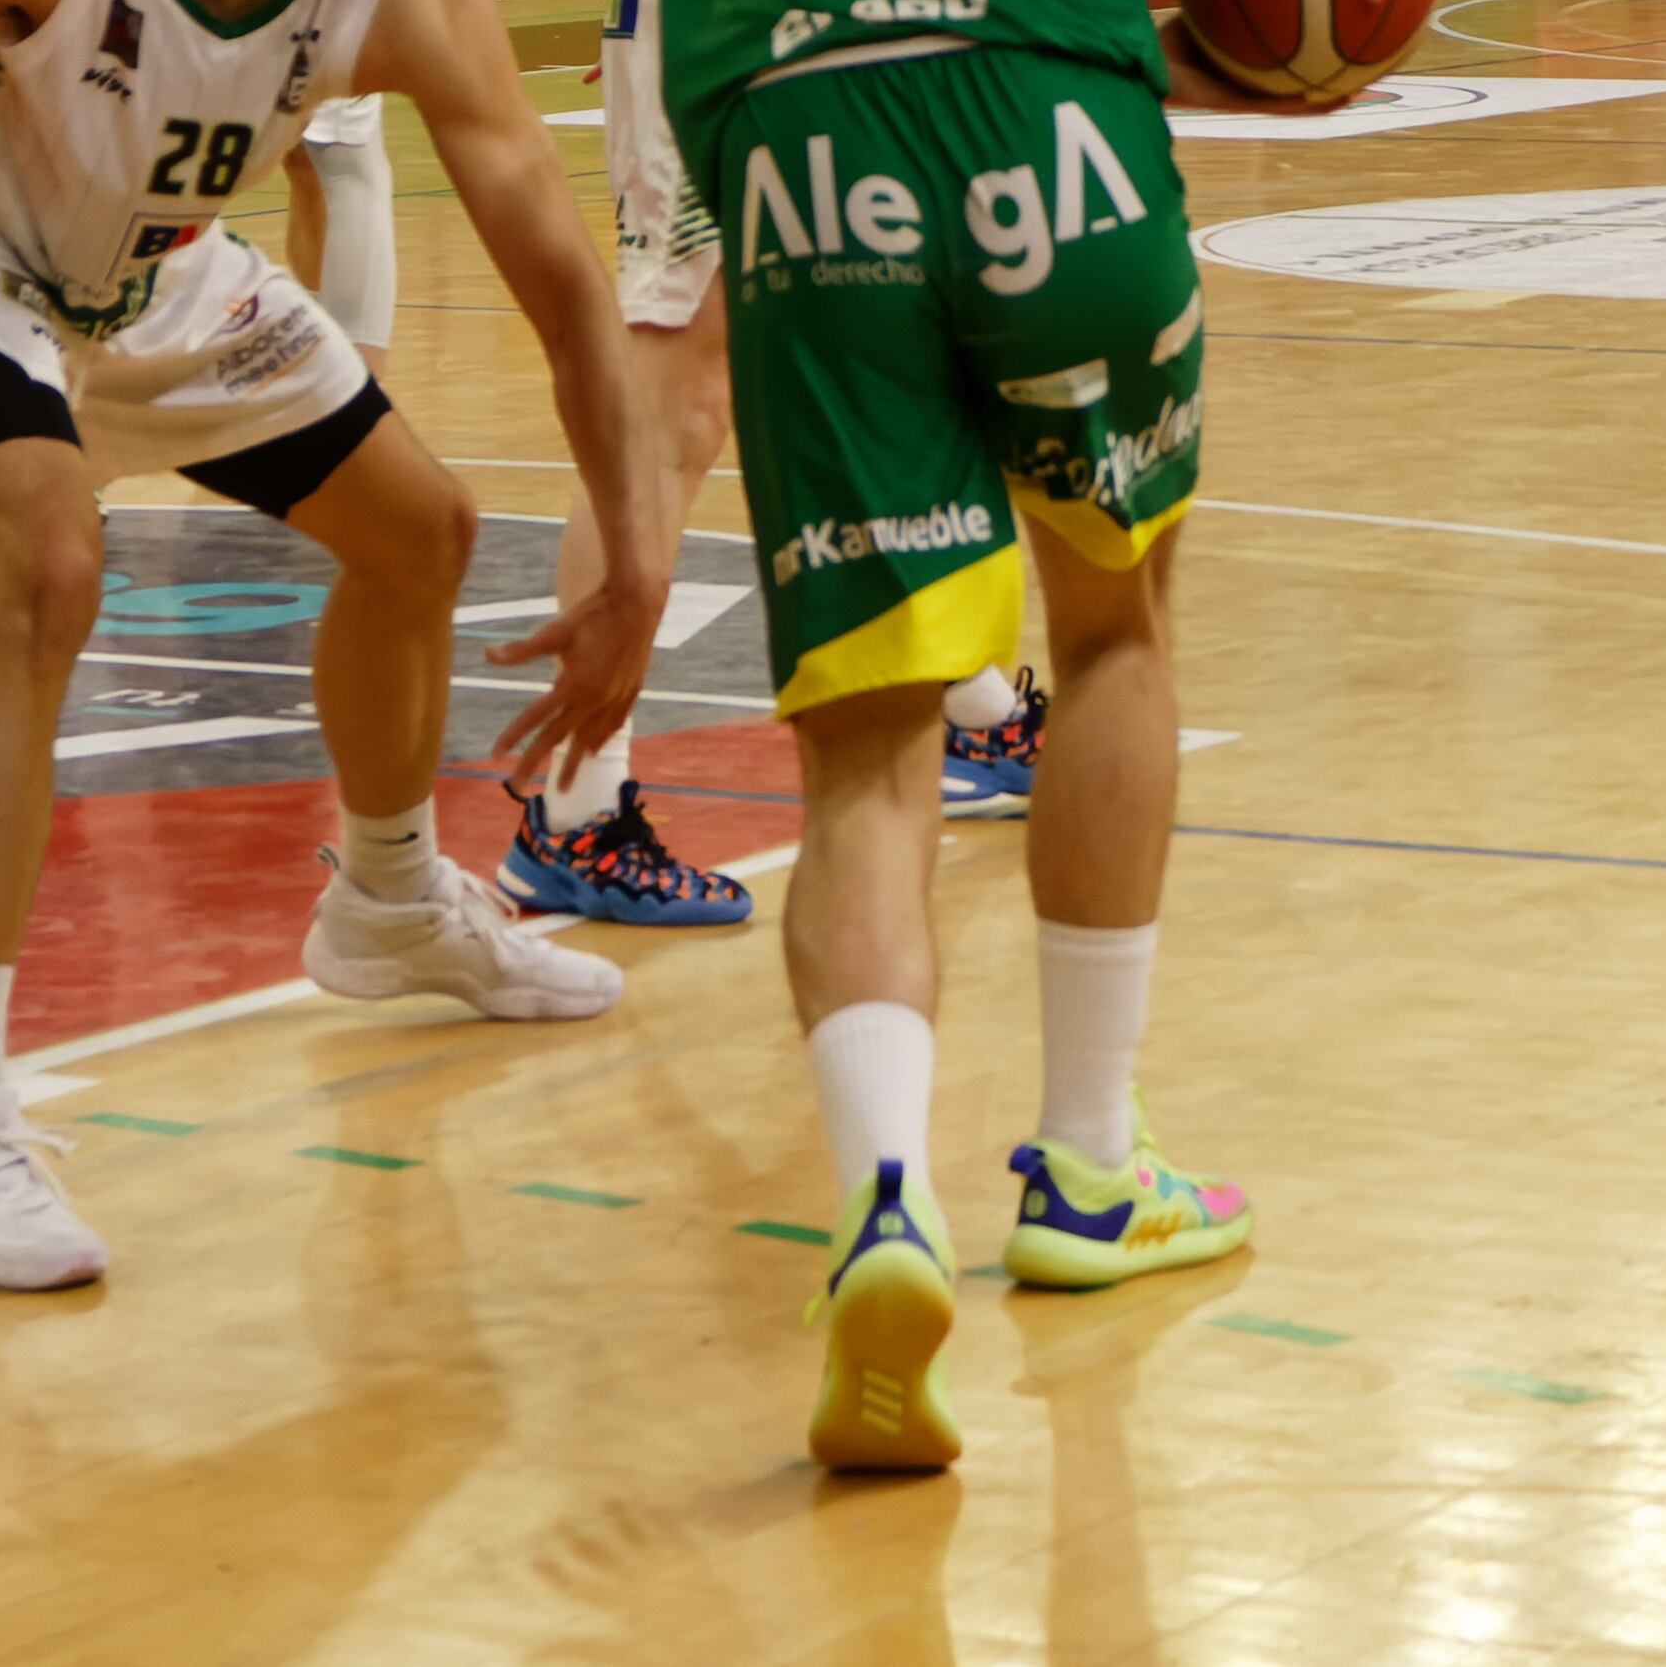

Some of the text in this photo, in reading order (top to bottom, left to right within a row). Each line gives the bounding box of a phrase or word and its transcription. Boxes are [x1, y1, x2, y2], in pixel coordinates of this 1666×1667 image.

[148, 117, 254, 197] 28
[740, 100, 1149, 297] AlegA
[810, 260, 926, 288] derecho
